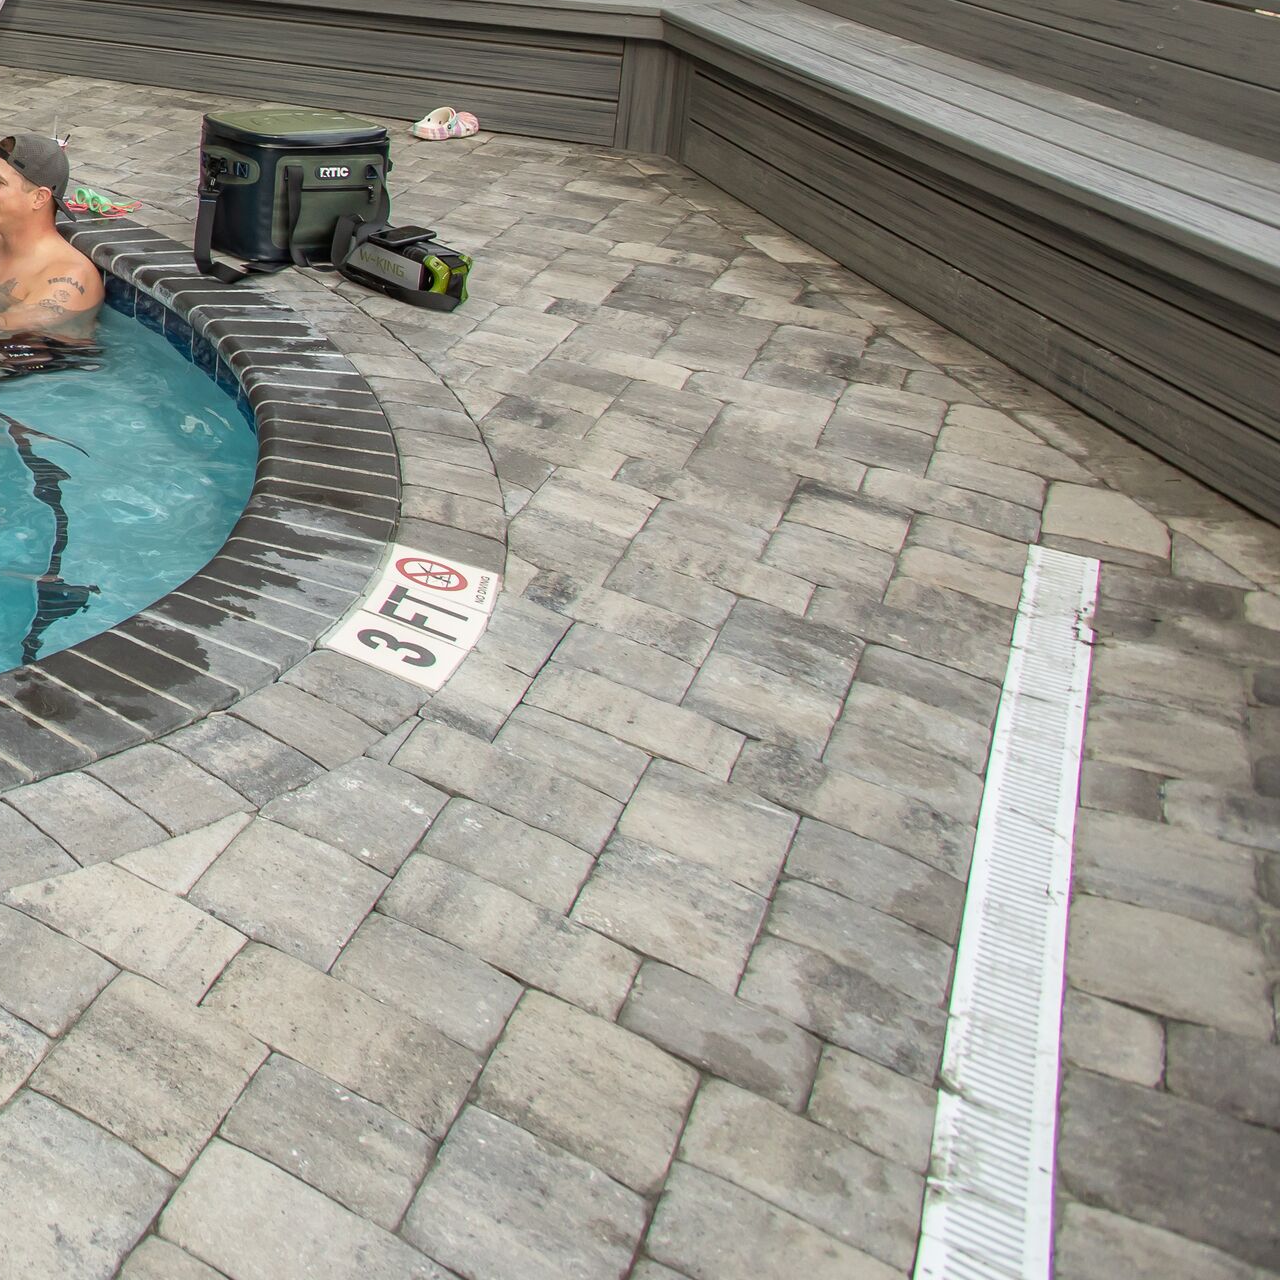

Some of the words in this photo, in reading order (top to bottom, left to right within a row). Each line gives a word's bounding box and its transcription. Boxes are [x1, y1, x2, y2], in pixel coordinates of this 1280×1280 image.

[320, 166, 349, 178] RTIC
[360, 248, 405, 278] W-KING
[477, 575, 490, 595] DIVING
[474, 594, 486, 605] NO
[379, 584, 469, 642] FT
[357, 628, 436, 668] 3
